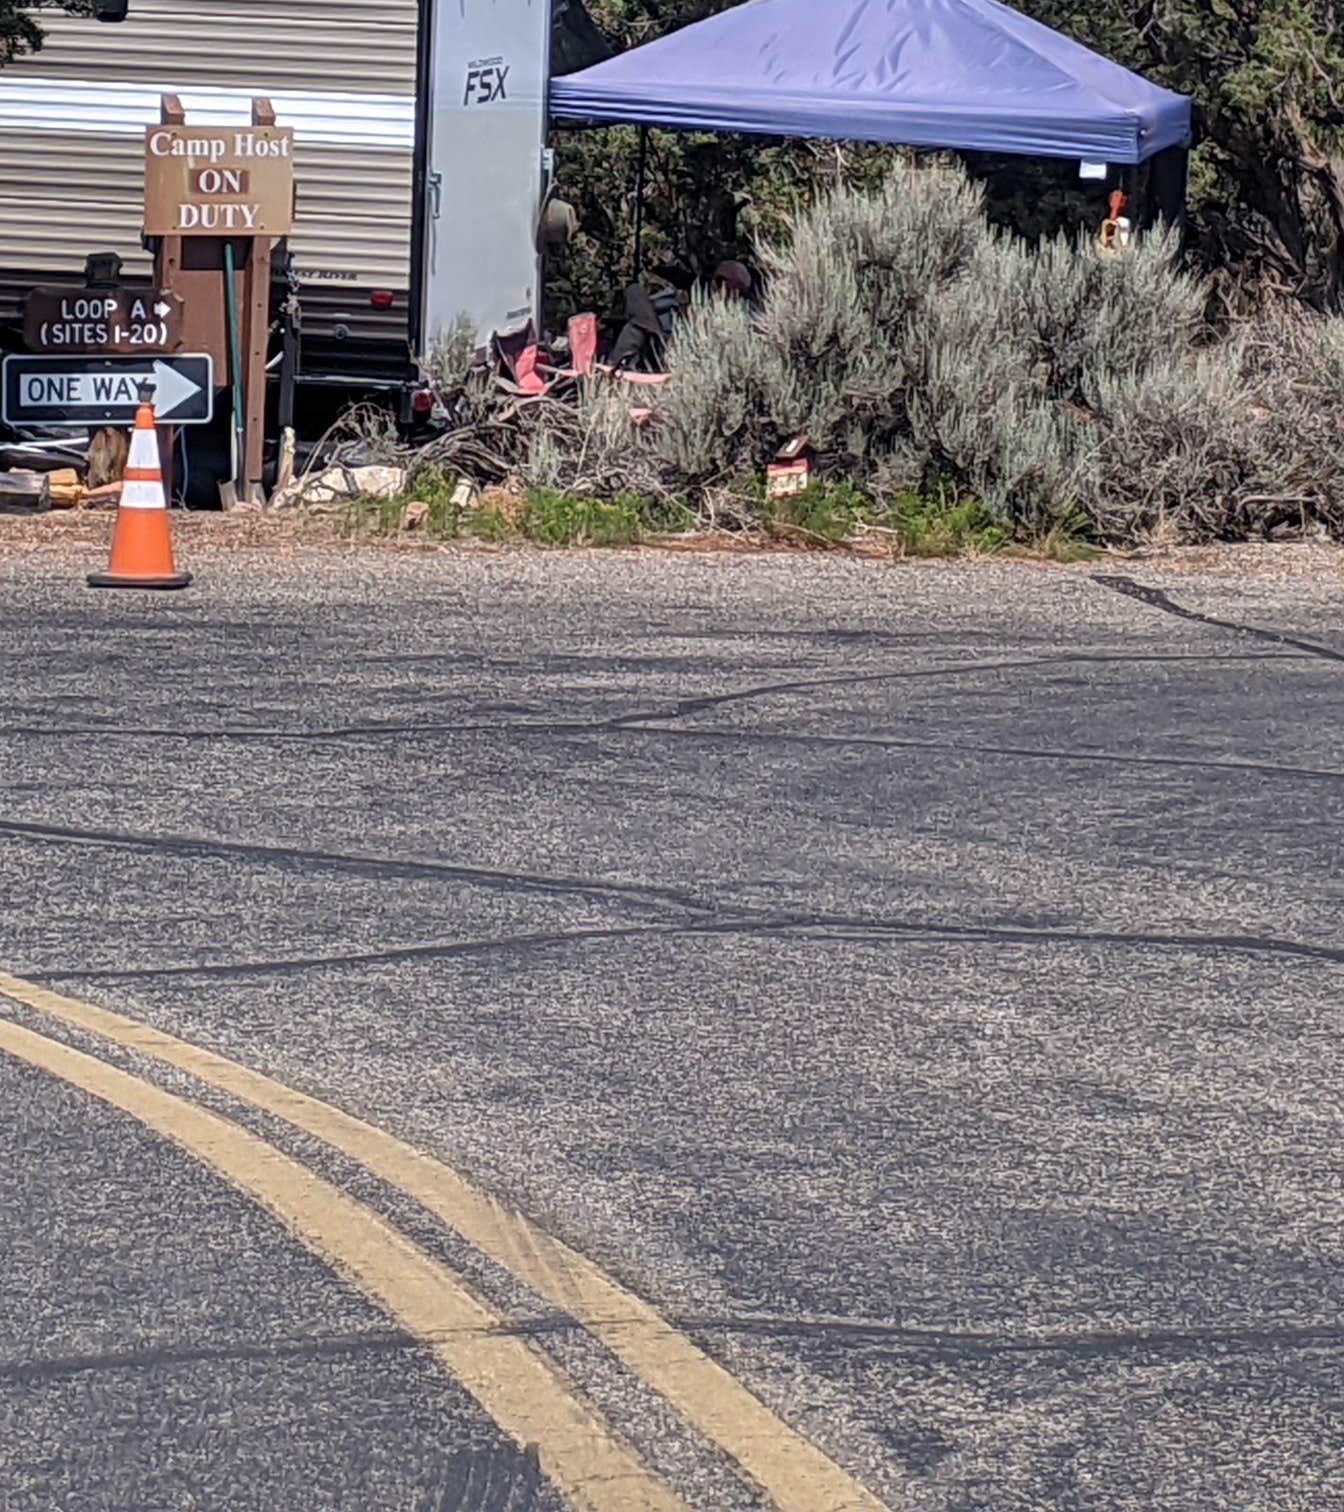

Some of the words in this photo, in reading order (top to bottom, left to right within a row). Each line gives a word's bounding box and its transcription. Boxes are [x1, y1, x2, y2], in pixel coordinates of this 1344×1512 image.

[464, 65, 510, 106] FSX
[150, 132, 225, 163] Camp
[234, 133, 289, 157] Host
[199, 169, 242, 193] ON
[178, 204, 260, 228] DUTY
[62, 299, 118, 319] LOOP
[131, 299, 146, 319] A
[40, 322, 108, 345] (SITES
[114, 322, 168, 345] 1-20)
[28, 377, 82, 402] ONE
